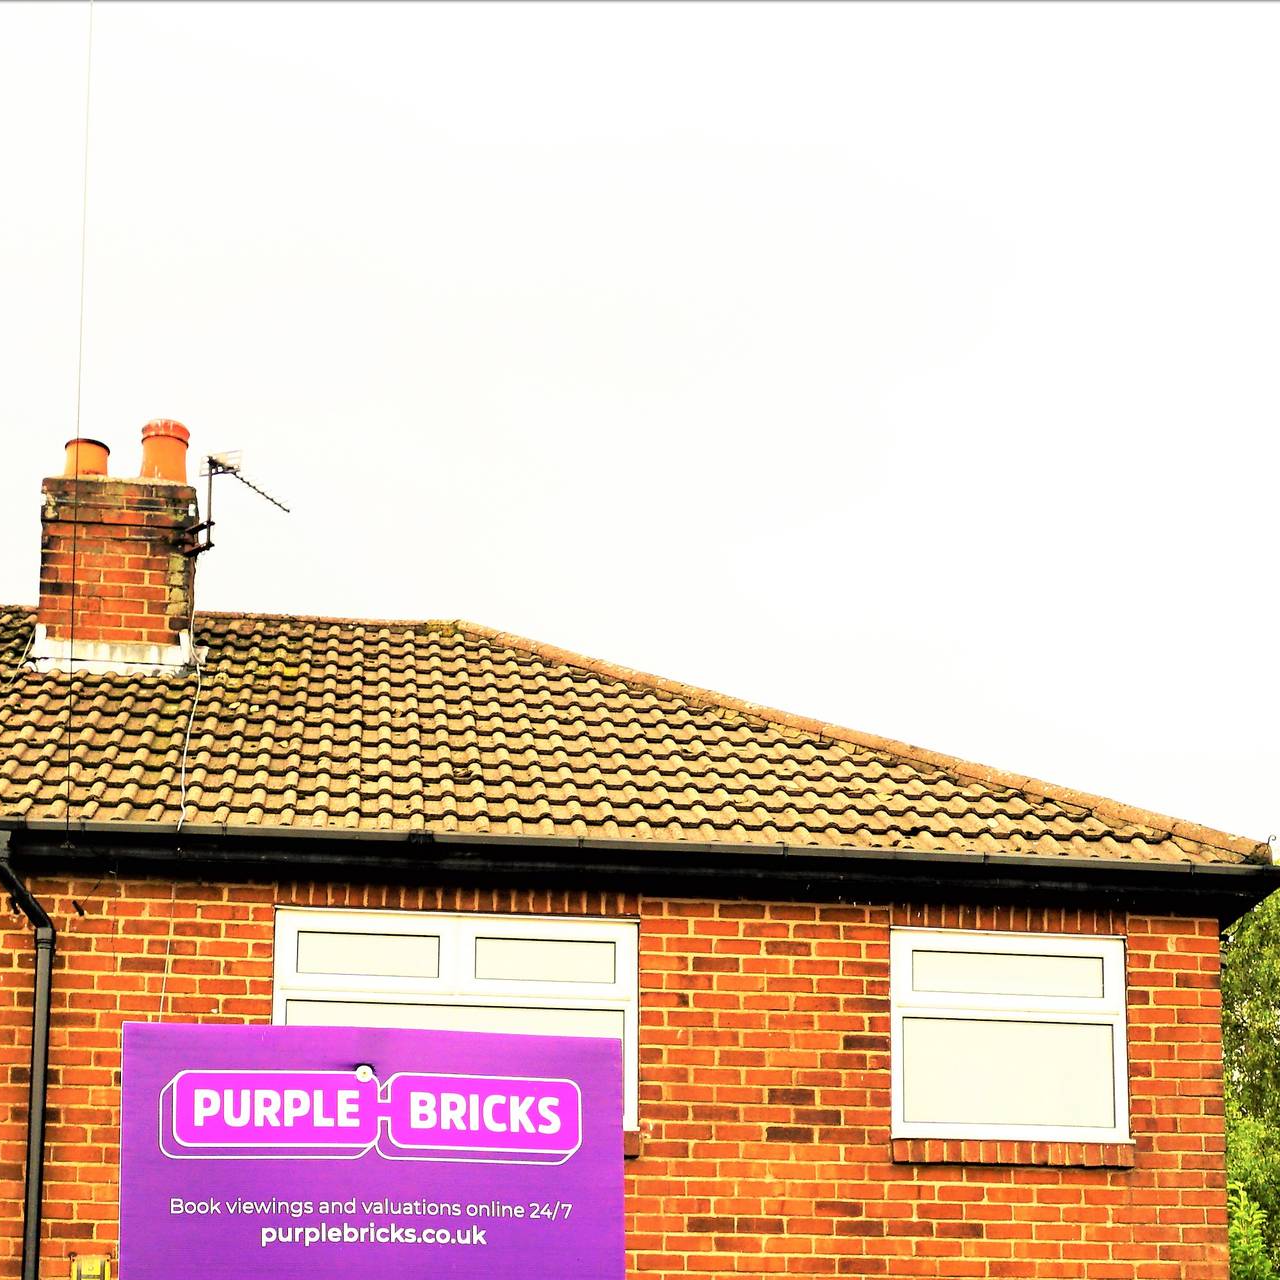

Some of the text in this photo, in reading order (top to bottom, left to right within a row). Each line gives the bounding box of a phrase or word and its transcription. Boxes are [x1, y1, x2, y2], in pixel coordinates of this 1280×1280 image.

[194, 1089, 561, 1134] PURPLE BRICKS
[170, 1198, 573, 1221] Book viewings and valuations online 24/7
[261, 1223, 487, 1247] purplebricks.co.uk
